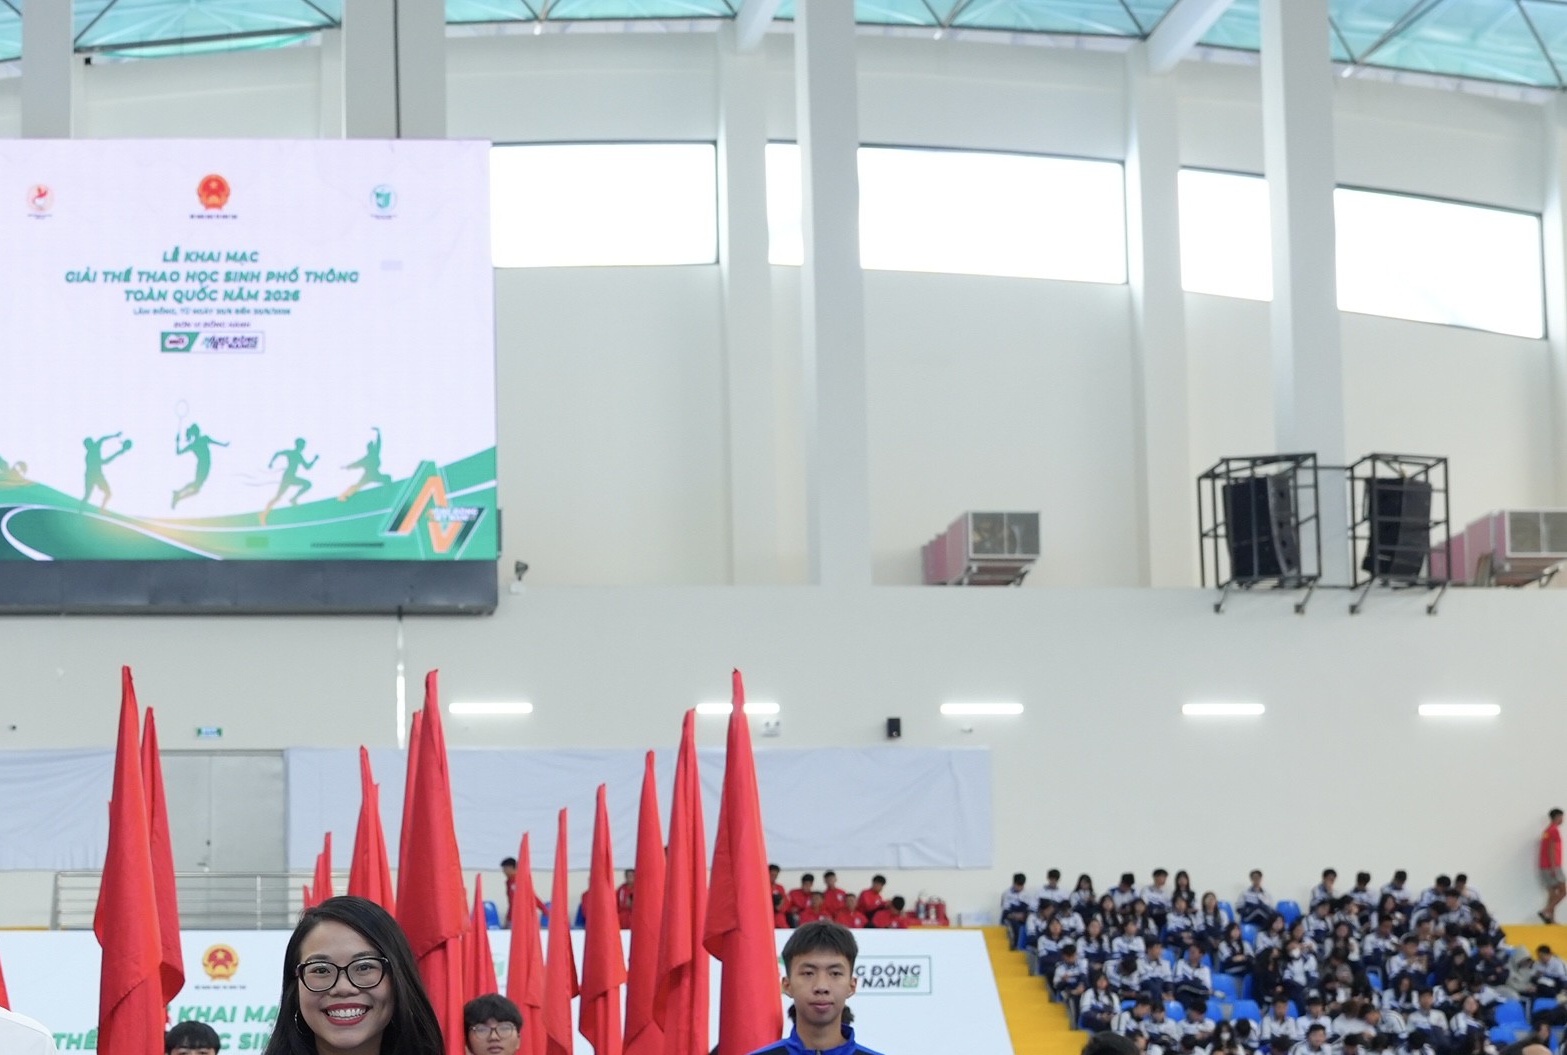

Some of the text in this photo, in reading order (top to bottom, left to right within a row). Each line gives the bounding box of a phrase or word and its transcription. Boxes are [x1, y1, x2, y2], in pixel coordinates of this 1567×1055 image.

[185, 251, 221, 263] KHAI
[137, 270, 181, 284] THAO
[224, 270, 262, 284] SINH
[305, 268, 360, 284] THÔNG
[125, 287, 169, 302] TOÀN
[264, 289, 301, 302] 2026
[861, 977, 901, 988] NAM
[178, 1005, 237, 1023] KHAI
[244, 1005, 278, 1027] MẠ
